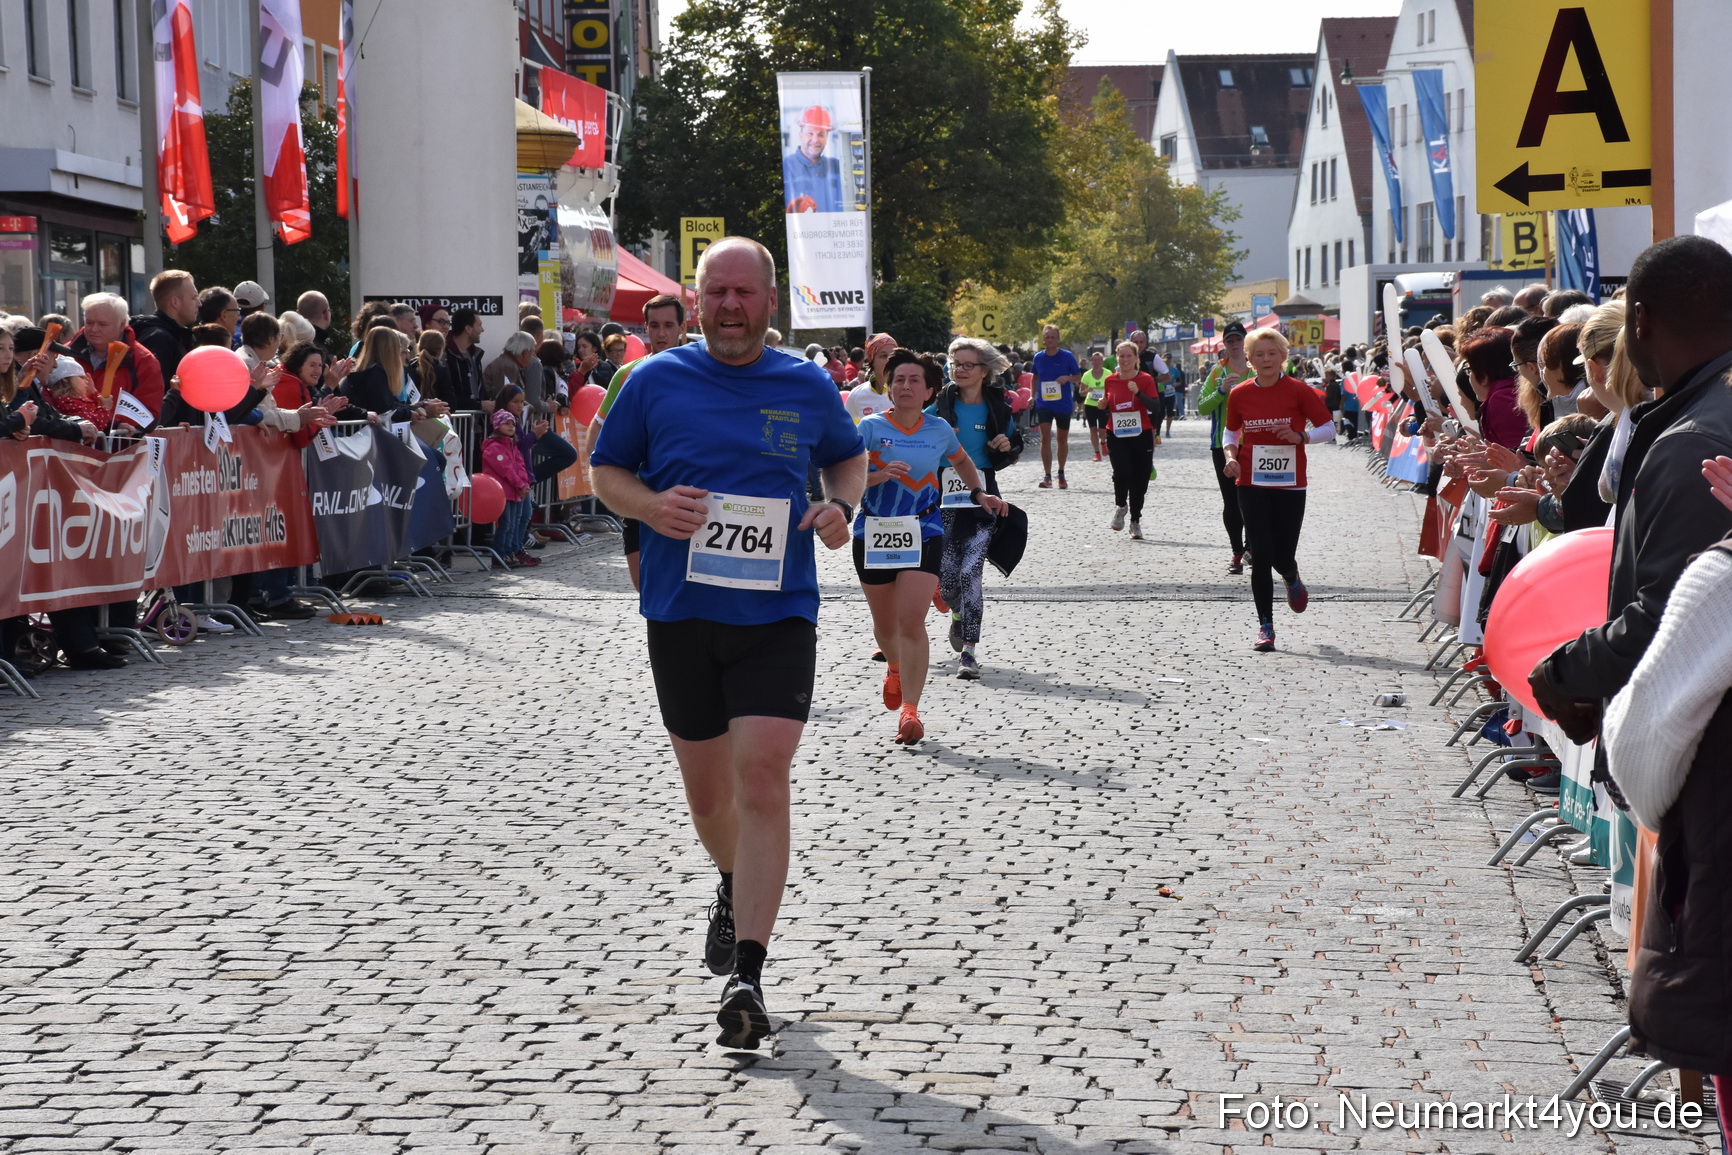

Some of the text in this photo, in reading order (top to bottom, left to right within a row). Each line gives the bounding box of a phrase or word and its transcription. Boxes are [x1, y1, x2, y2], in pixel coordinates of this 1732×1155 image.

[1516, 7, 1631, 148] A
[685, 220, 720, 232] Block
[1513, 221, 1538, 255] B
[982, 313, 995, 332] C
[1311, 326, 1321, 340] D
[118, 399, 140, 413] swn
[1116, 418, 1137, 428] 2328
[1258, 458, 1290, 471] 2507
[181, 461, 217, 496] meisten
[733, 503, 766, 514] BOCK
[265, 504, 285, 542] Hits
[705, 521, 773, 553] 2764
[872, 532, 913, 548] 2259
